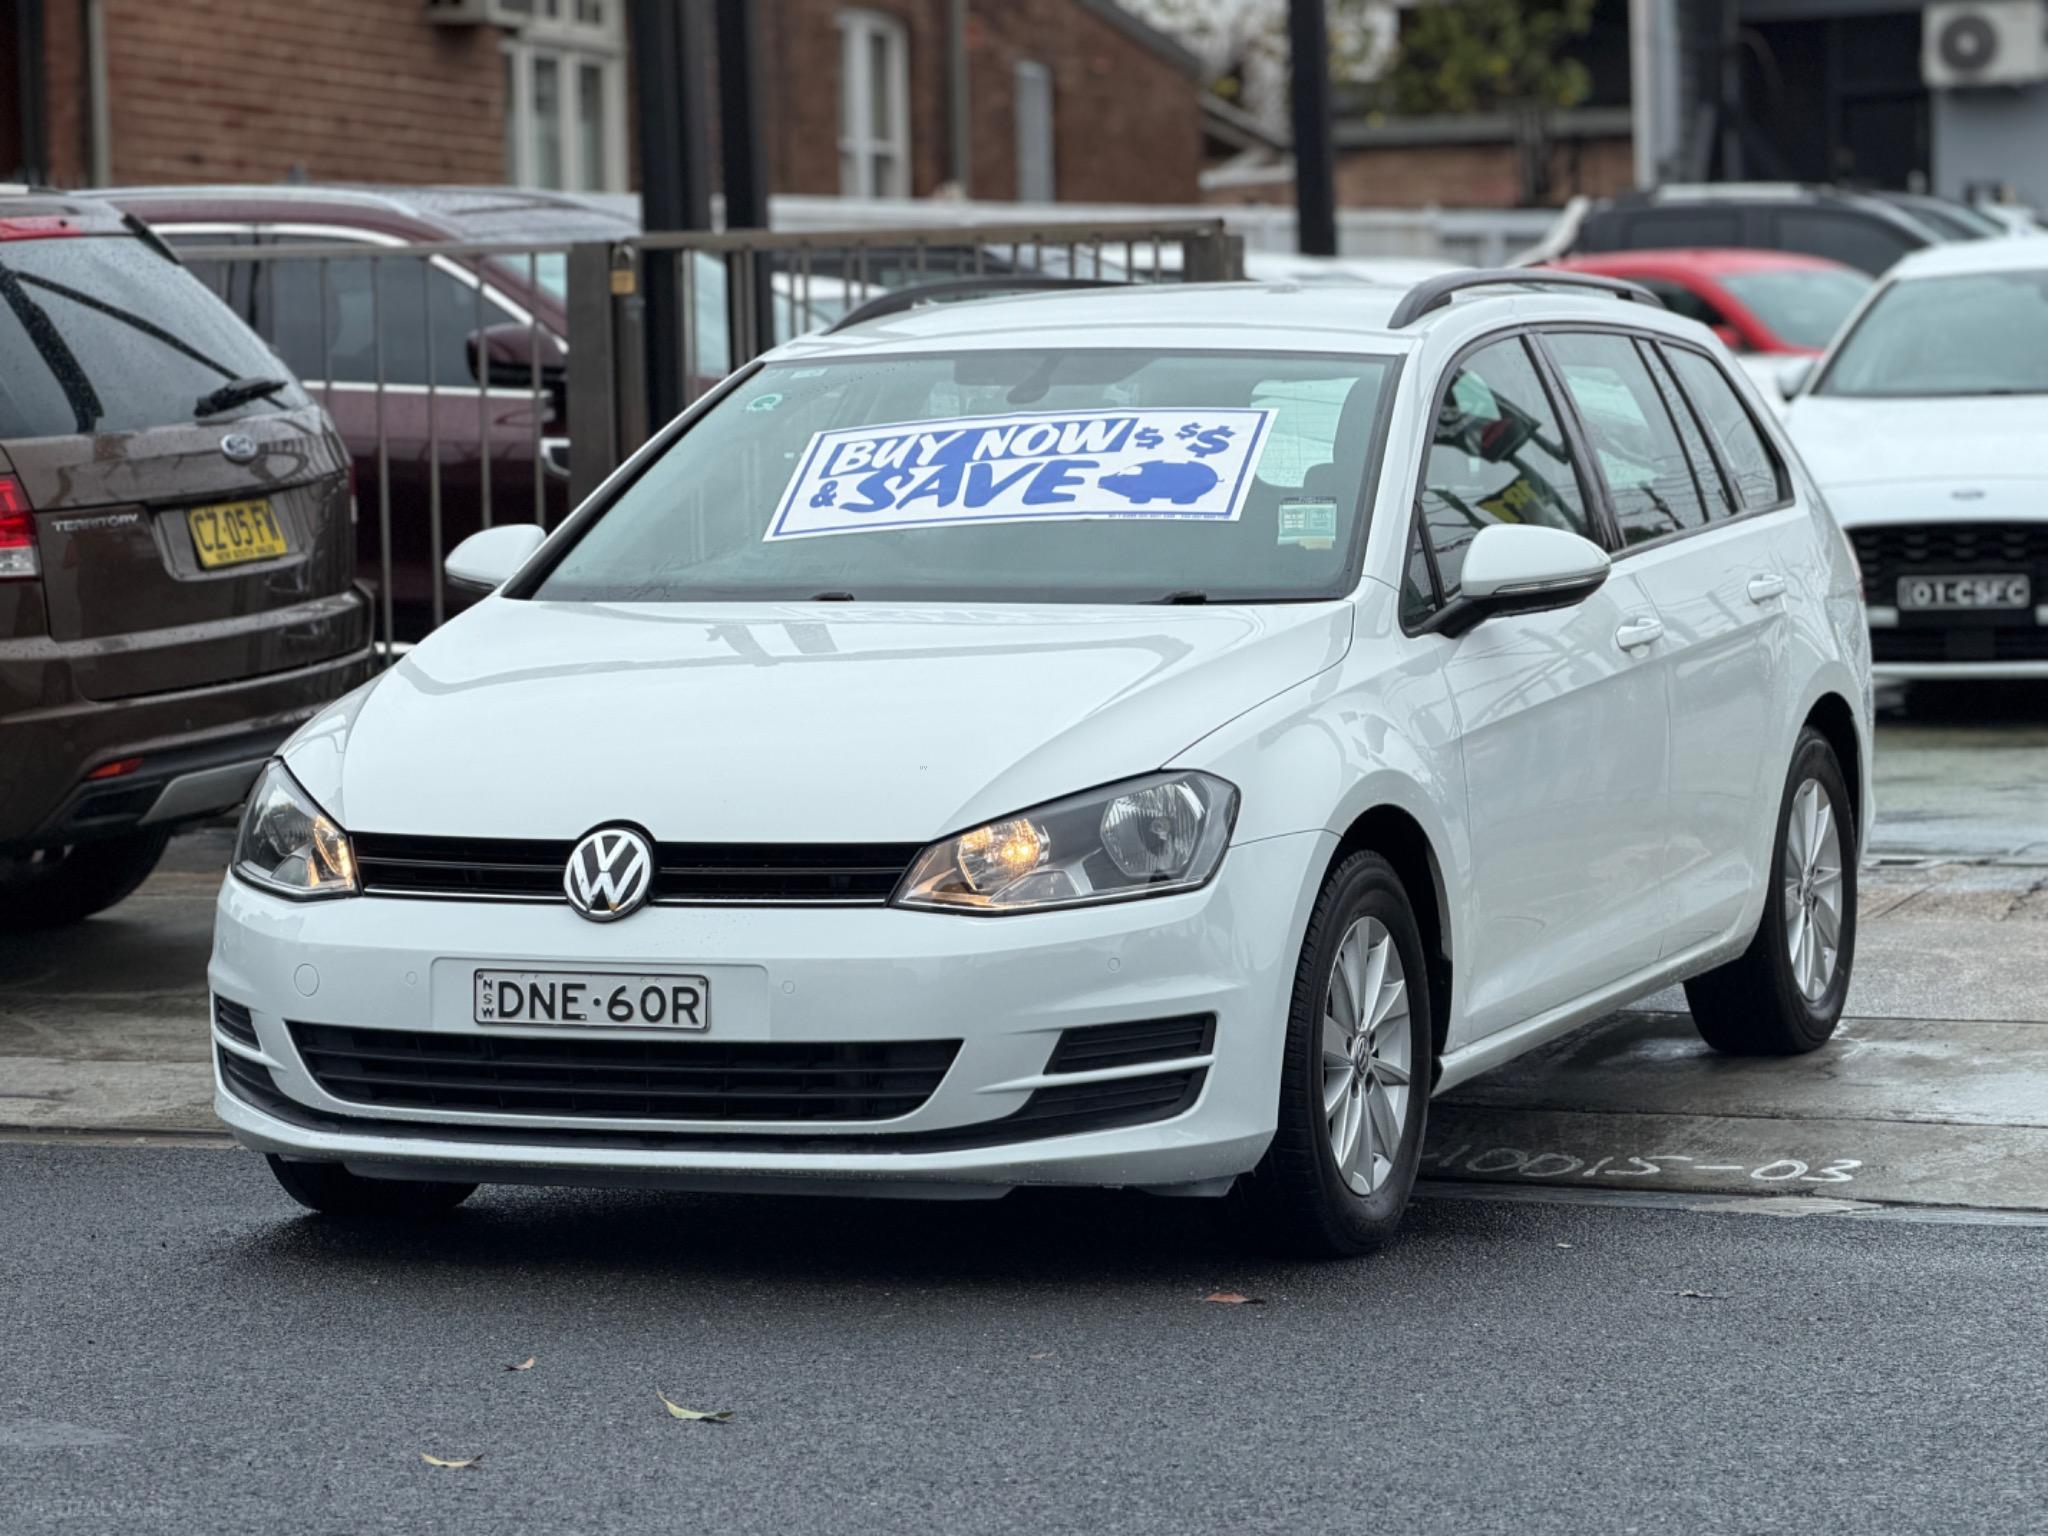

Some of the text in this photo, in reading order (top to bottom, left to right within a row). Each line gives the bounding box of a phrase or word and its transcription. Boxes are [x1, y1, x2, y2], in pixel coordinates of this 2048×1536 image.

[829, 430, 967, 476] BUY
[972, 418, 1132, 461] NOW
[809, 459, 1101, 513] & SAVE
[52, 513, 139, 533] TERRITORY
